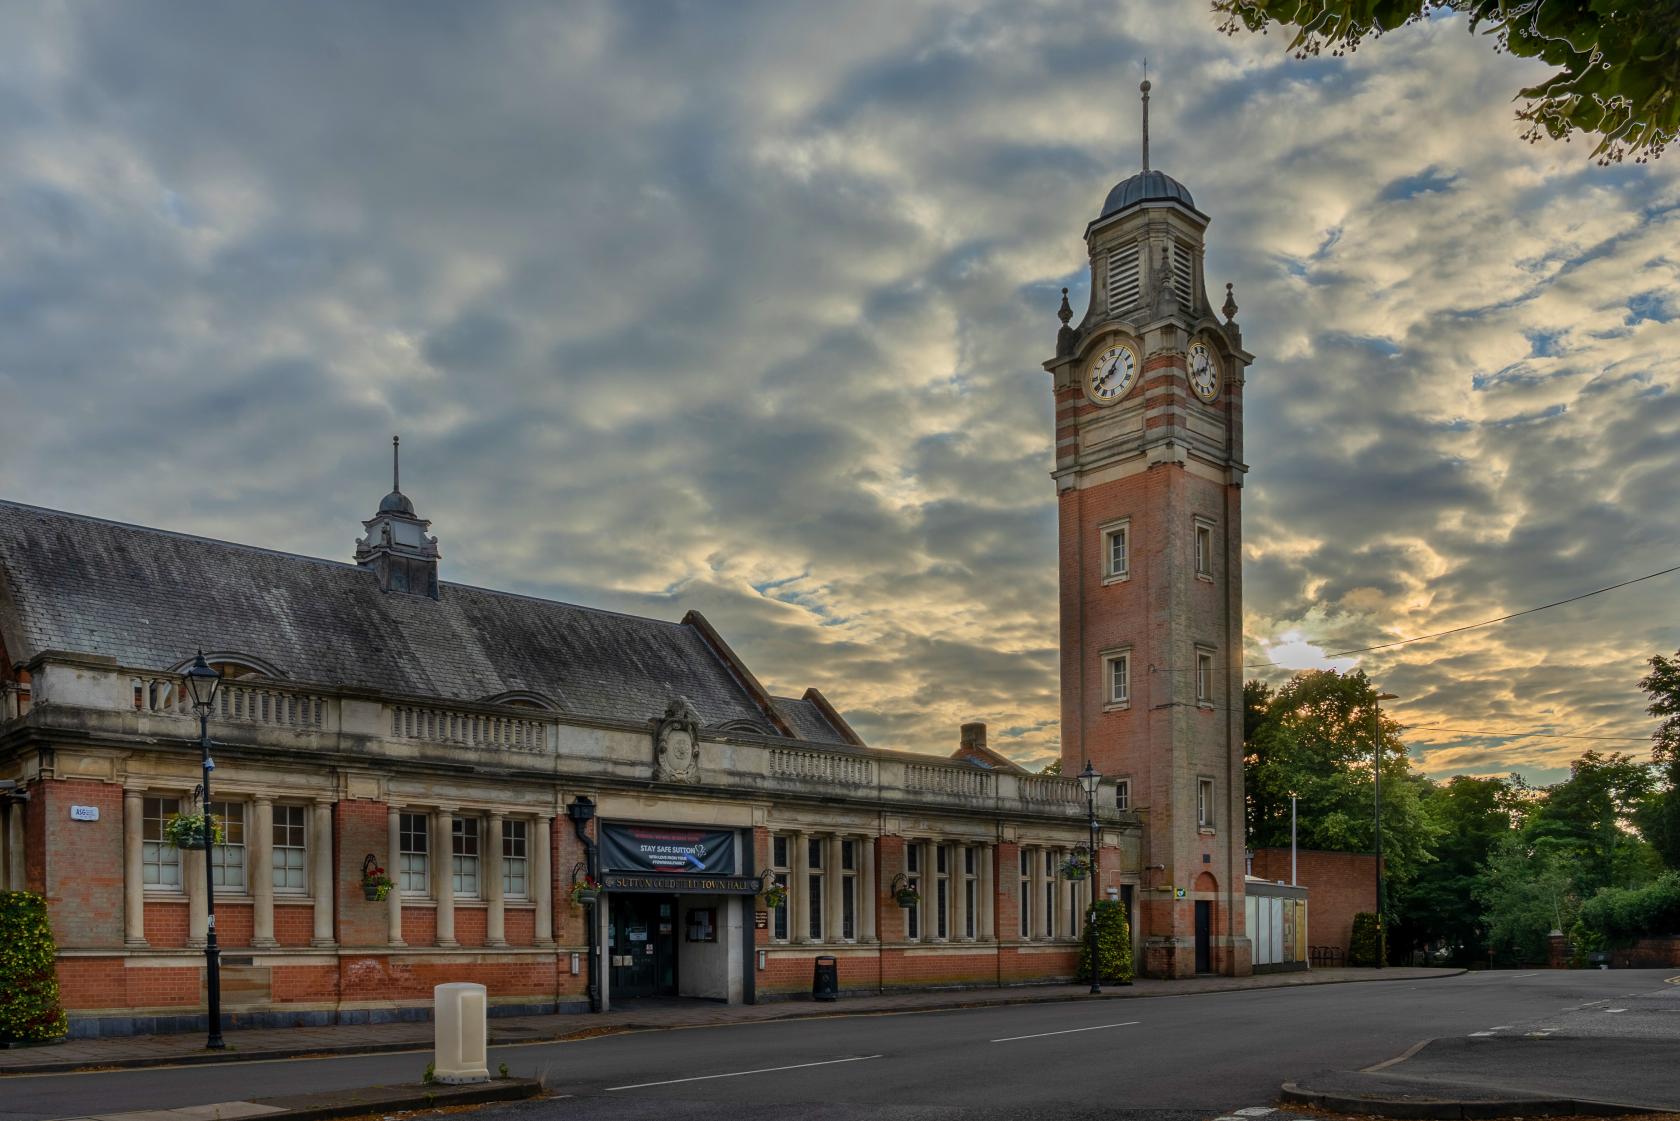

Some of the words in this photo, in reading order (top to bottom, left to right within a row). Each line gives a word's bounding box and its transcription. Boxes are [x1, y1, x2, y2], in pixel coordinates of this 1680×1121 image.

[640, 844, 656, 852] STAY
[656, 845, 672, 853] SAFE
[672, 846, 696, 854] SUTTON
[616, 878, 652, 888] SUTTON
[702, 880, 725, 889] TOWN
[727, 880, 748, 890] HALL
